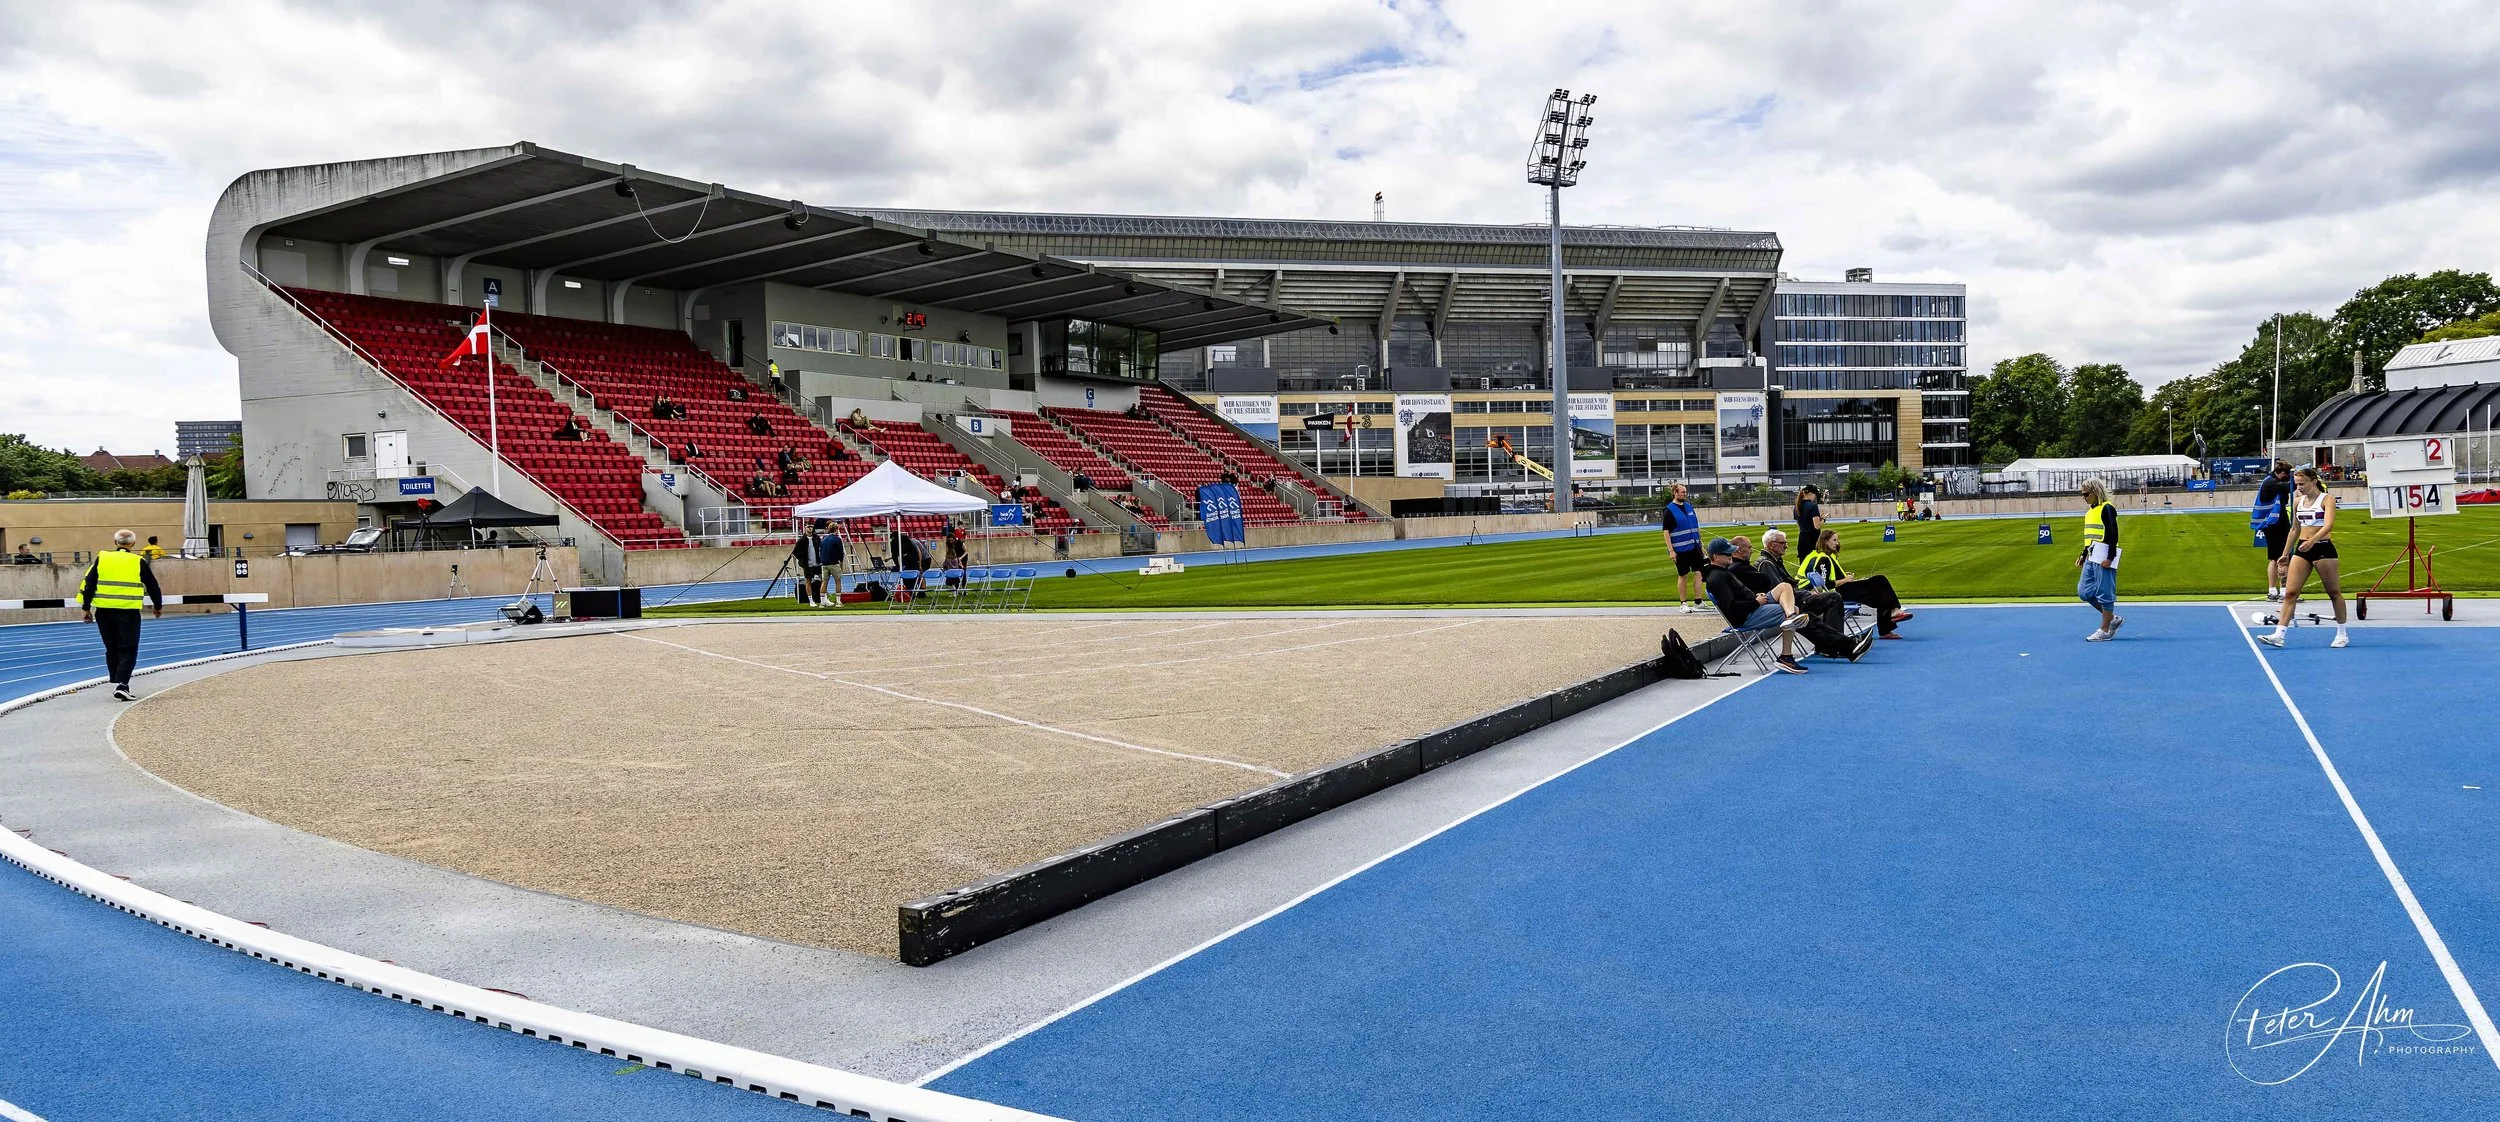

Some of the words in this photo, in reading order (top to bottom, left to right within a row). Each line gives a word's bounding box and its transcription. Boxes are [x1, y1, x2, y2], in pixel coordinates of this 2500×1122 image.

[488, 281, 498, 292] A
[2426, 438, 2442, 461] 2
[402, 482, 432, 491] TOILETTER
[1885, 528, 1894, 536] 60
[2039, 529, 2050, 538] 50
